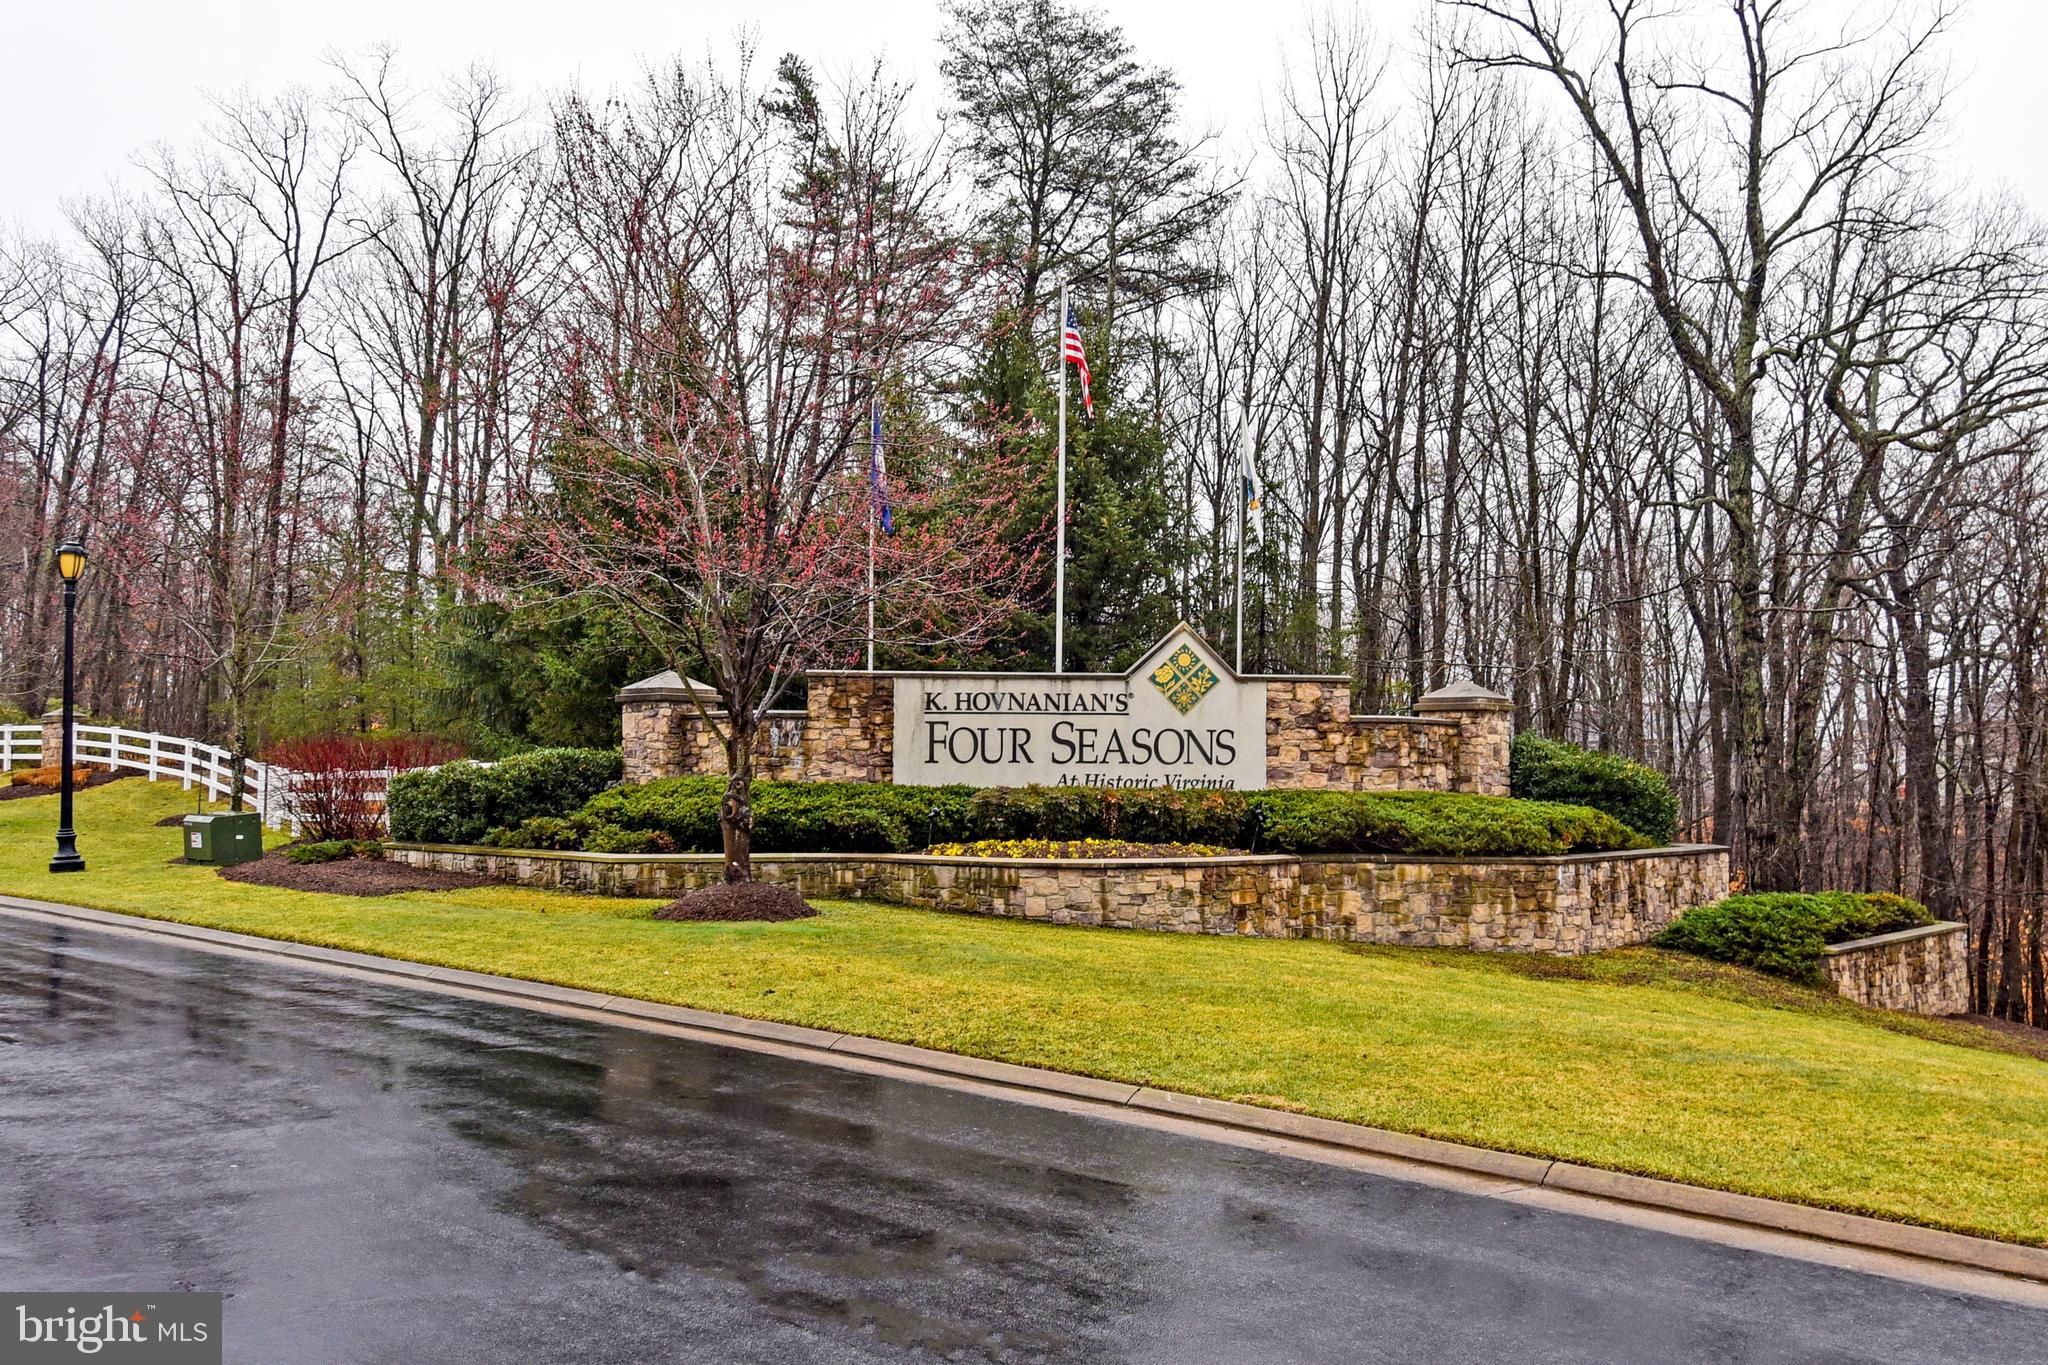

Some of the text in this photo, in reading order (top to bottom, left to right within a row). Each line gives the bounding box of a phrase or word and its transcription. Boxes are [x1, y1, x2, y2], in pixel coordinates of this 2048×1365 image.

[924, 692, 948, 711] K.
[924, 720, 1236, 765] FOUR SEASONS
[1056, 773, 1078, 787] At
[1084, 773, 1158, 789] Historic
